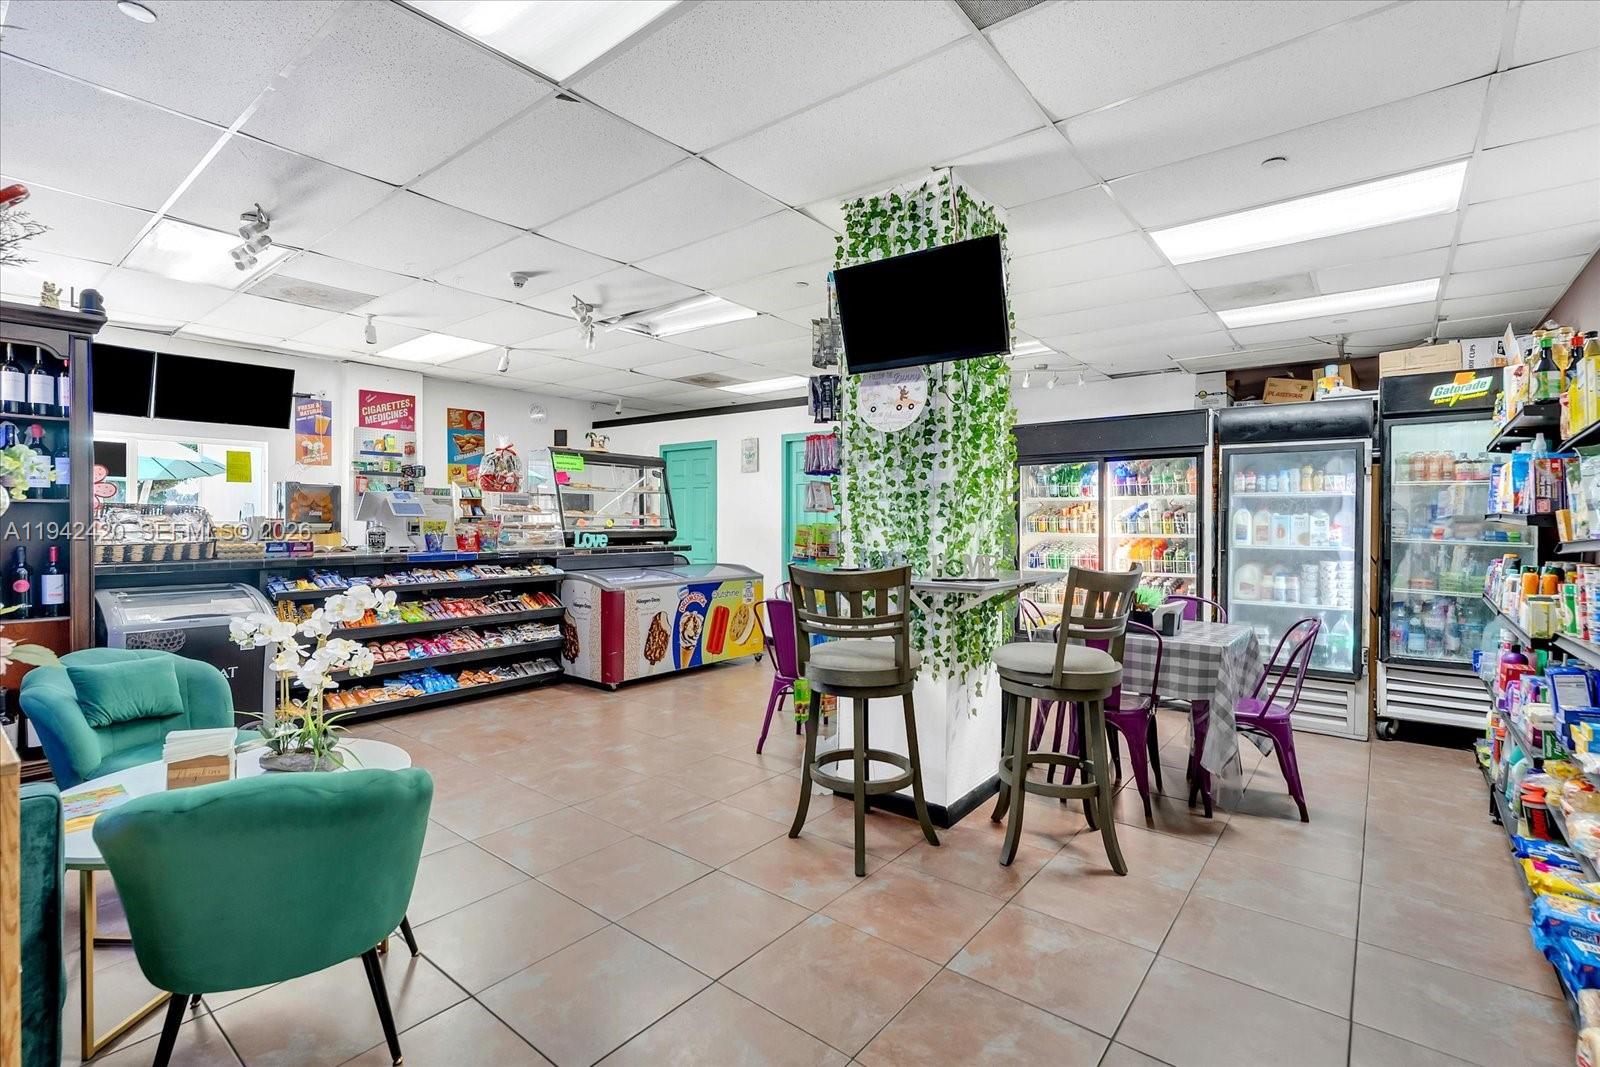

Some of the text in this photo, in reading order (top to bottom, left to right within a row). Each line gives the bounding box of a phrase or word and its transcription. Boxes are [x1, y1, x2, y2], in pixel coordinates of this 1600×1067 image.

[1434, 380, 1487, 397] Gatorade
[361, 399, 413, 416] CIGARETTES,
[364, 408, 409, 425] MEDICINES
[574, 530, 608, 548] Love
